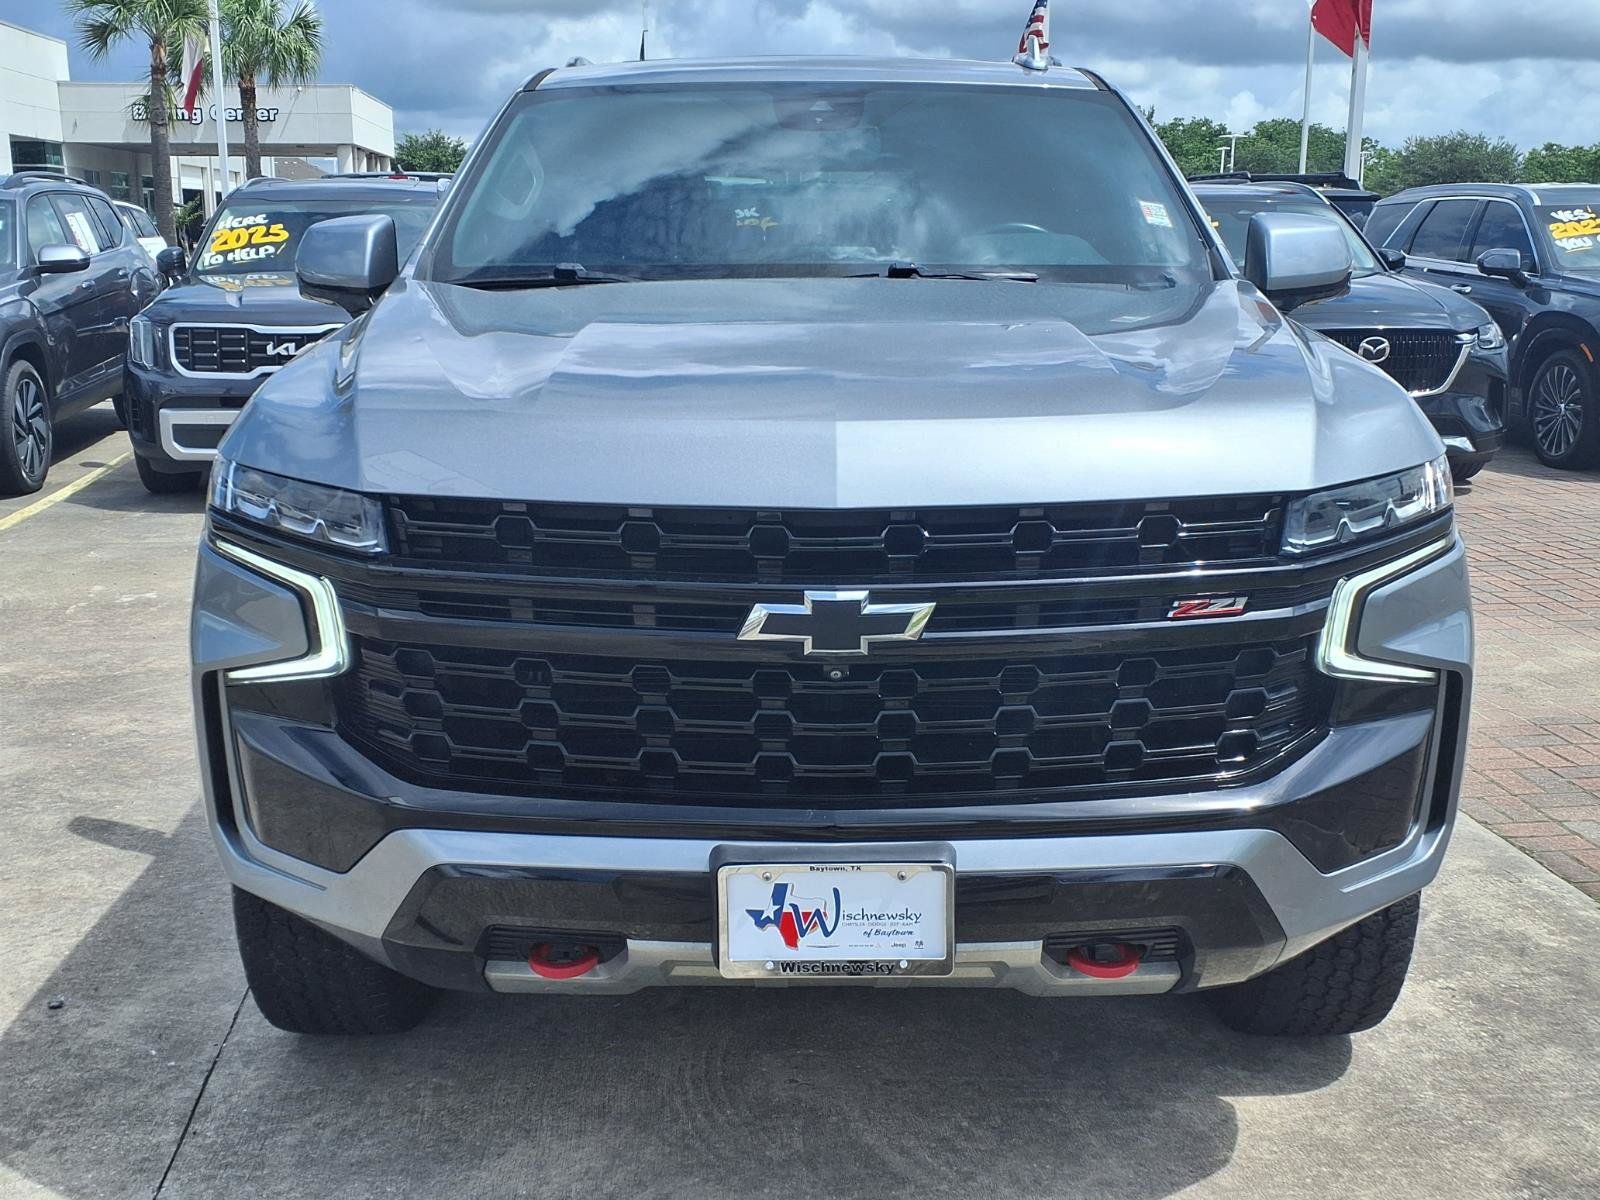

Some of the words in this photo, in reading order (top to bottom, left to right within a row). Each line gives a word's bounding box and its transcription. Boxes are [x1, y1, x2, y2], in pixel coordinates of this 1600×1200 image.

[1549, 218, 1600, 239] 202
[211, 224, 290, 252] 2025
[863, 929, 873, 938] of
[874, 929, 914, 937] Baytown
[781, 962, 895, 976] Wischnewsky
